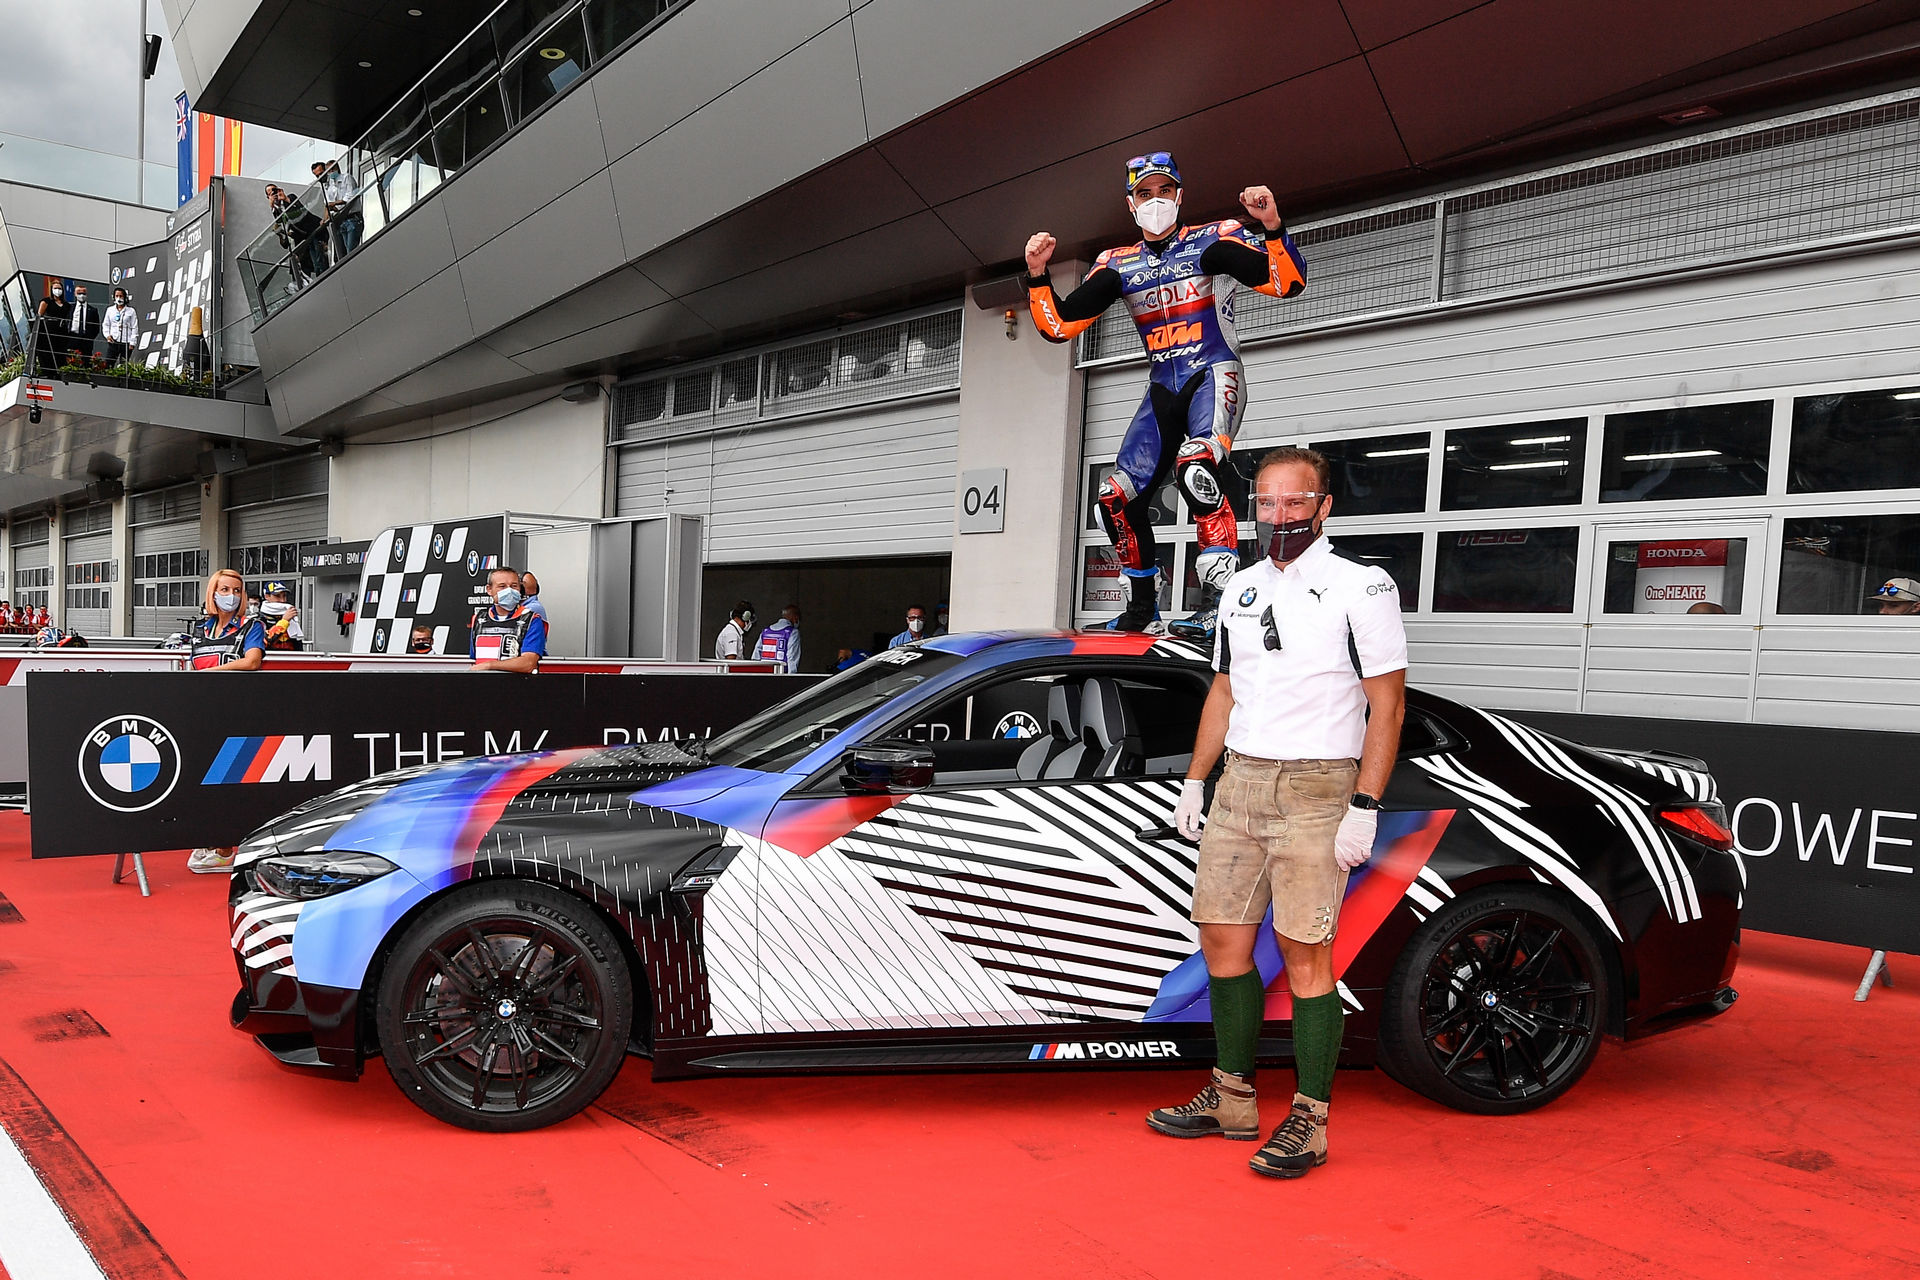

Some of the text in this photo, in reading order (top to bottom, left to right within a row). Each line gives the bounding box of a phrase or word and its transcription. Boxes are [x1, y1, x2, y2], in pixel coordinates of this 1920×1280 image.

[1186, 230, 1206, 241] elf
[1135, 261, 1194, 285] ORGANICS
[1145, 281, 1200, 309] COLA
[1146, 321, 1203, 351] KTM
[1152, 343, 1204, 362] IXON
[1224, 371, 1239, 416] COLA
[963, 485, 1001, 516] 04
[302, 555, 315, 567] BMW
[325, 554, 342, 566] POWER
[346, 552, 360, 564] BMW
[1646, 548, 1707, 558] HONDA
[1645, 585, 1706, 600] One HEART.
[92, 719, 168, 748] BMW
[1000, 715, 1038, 736] BMW
[259, 734, 332, 783] M
[353, 731, 465, 778] THE
[1731, 797, 1918, 874] OWE
[537, 905, 606, 962] MICHELIN
[1053, 1040, 1182, 1060] M POWER
